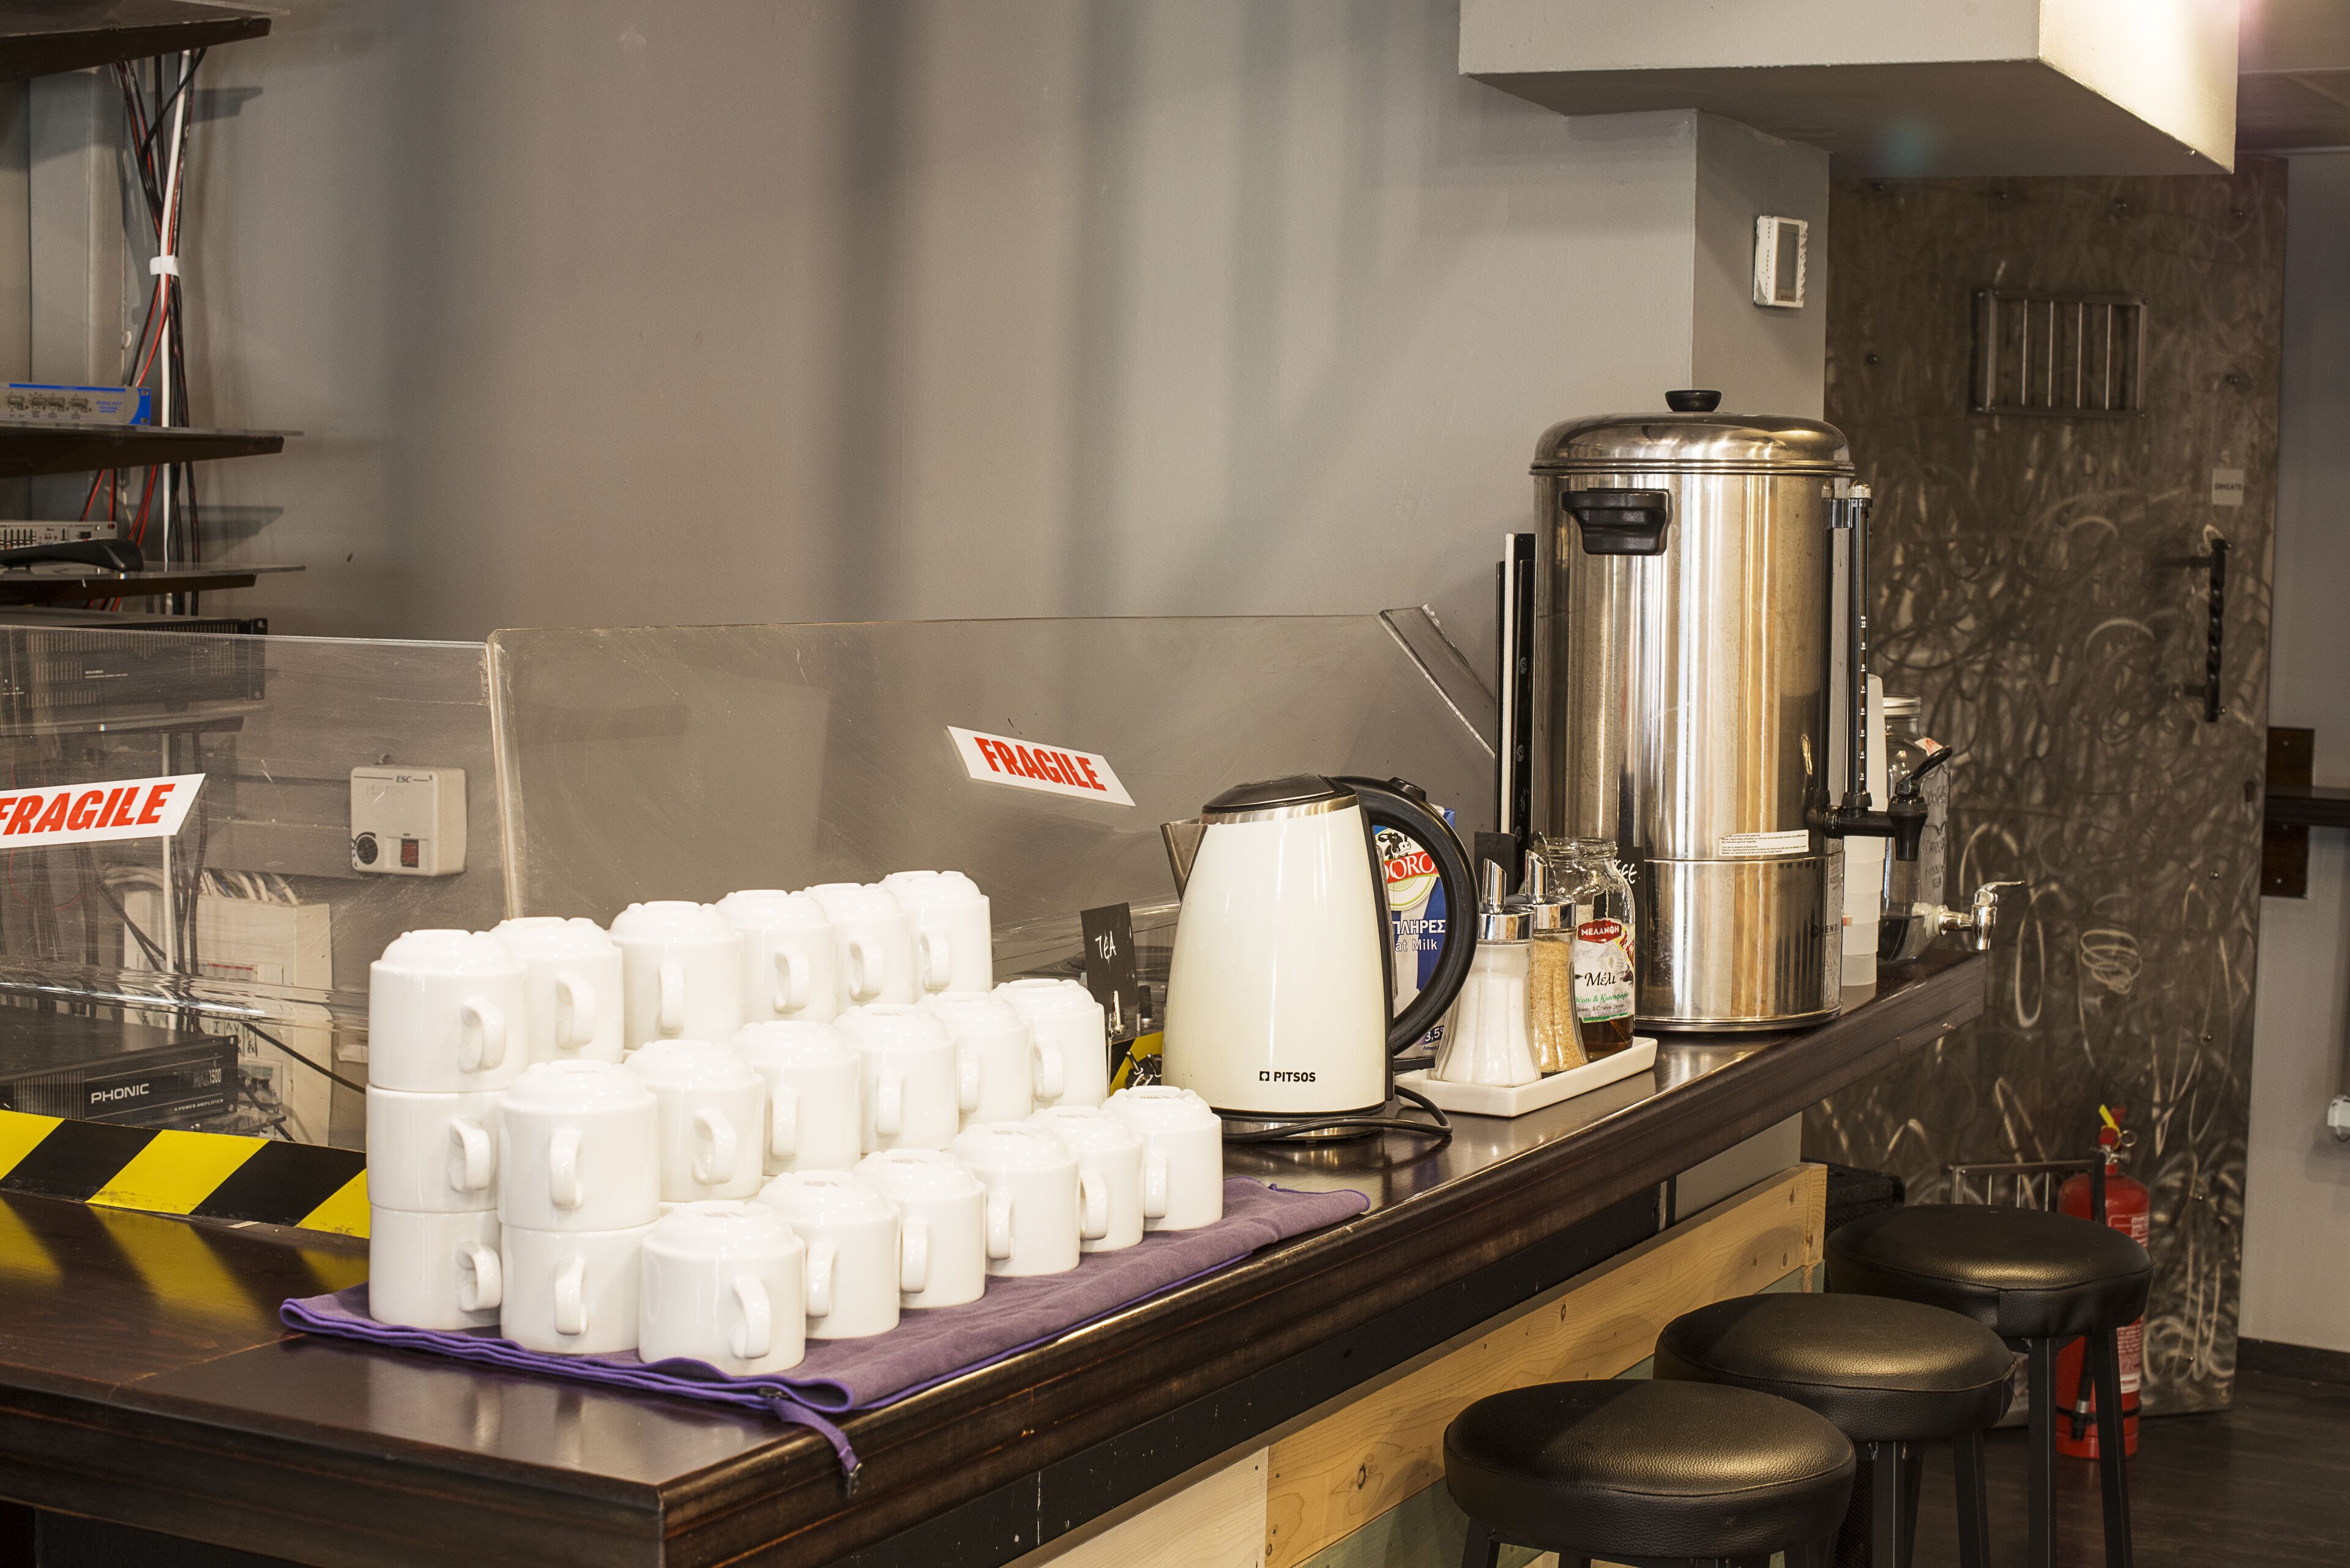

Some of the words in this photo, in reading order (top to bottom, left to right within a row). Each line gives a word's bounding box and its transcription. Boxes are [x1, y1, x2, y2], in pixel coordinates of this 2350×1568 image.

[974, 736, 1107, 791] FRAGILE
[396, 775, 412, 783] ESC
[1384, 853, 1435, 880] ORO
[1392, 919, 1446, 935] ΠΛΗΡΕΣ
[1581, 925, 1619, 936] ΜΕΛΑΝΘΗ
[1095, 931, 1116, 960] TEA
[1395, 939, 1408, 952] at
[1412, 938, 1438, 951] Milk
[1584, 971, 1616, 987] Μέλι
[1274, 1071, 1316, 1082] PITSOS
[91, 1083, 149, 1104] PHONIC
[196, 1098, 223, 1108] AMPLIFIER
